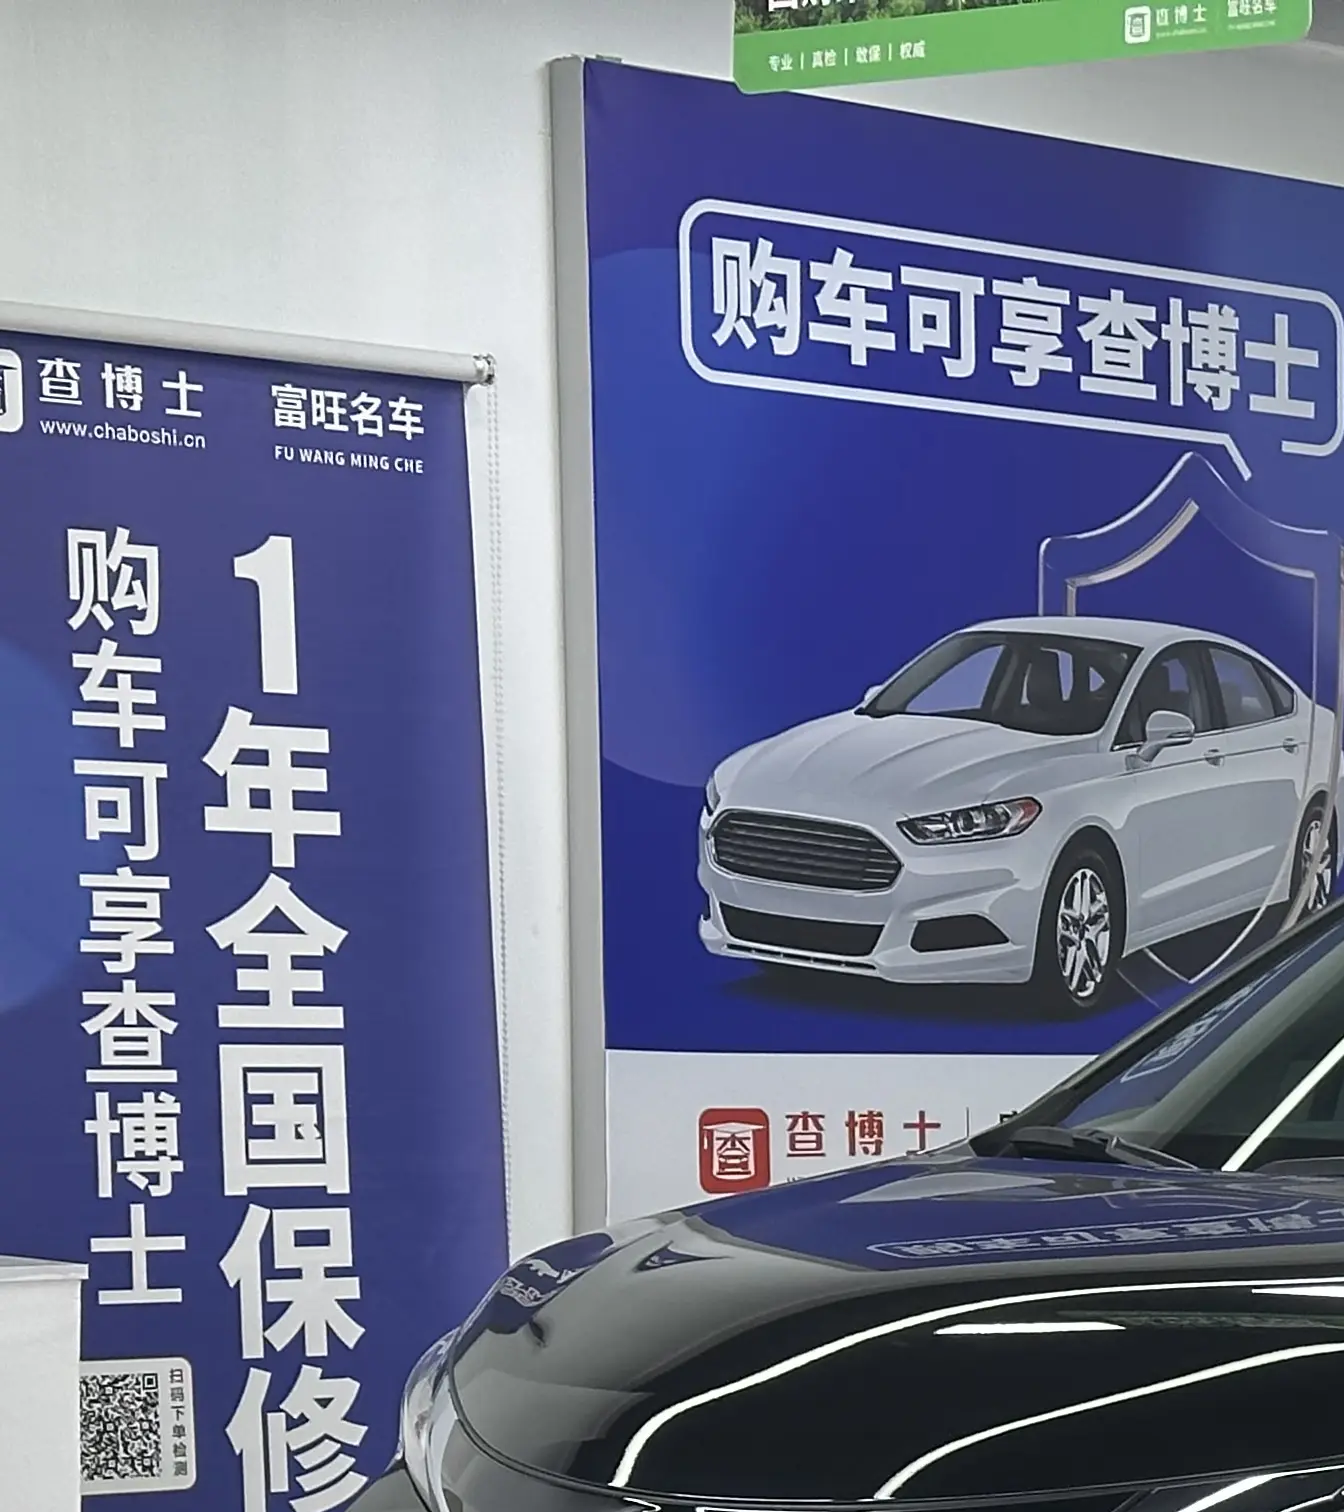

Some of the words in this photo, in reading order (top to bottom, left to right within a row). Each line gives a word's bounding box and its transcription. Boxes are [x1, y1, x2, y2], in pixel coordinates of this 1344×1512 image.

[711, 236, 1319, 420] 购车可享查博士
[37, 358, 203, 418] 查博士
[271, 383, 425, 440] 富旺名车
[40, 419, 206, 449] www.chaboshi.cn
[275, 445, 294, 461] FU
[300, 448, 345, 467] WANG
[350, 452, 390, 471] MING
[394, 457, 424, 474] CHE
[67, 526, 187, 1304] 购车可享查博士
[786, 1110, 940, 1157] 查博士
